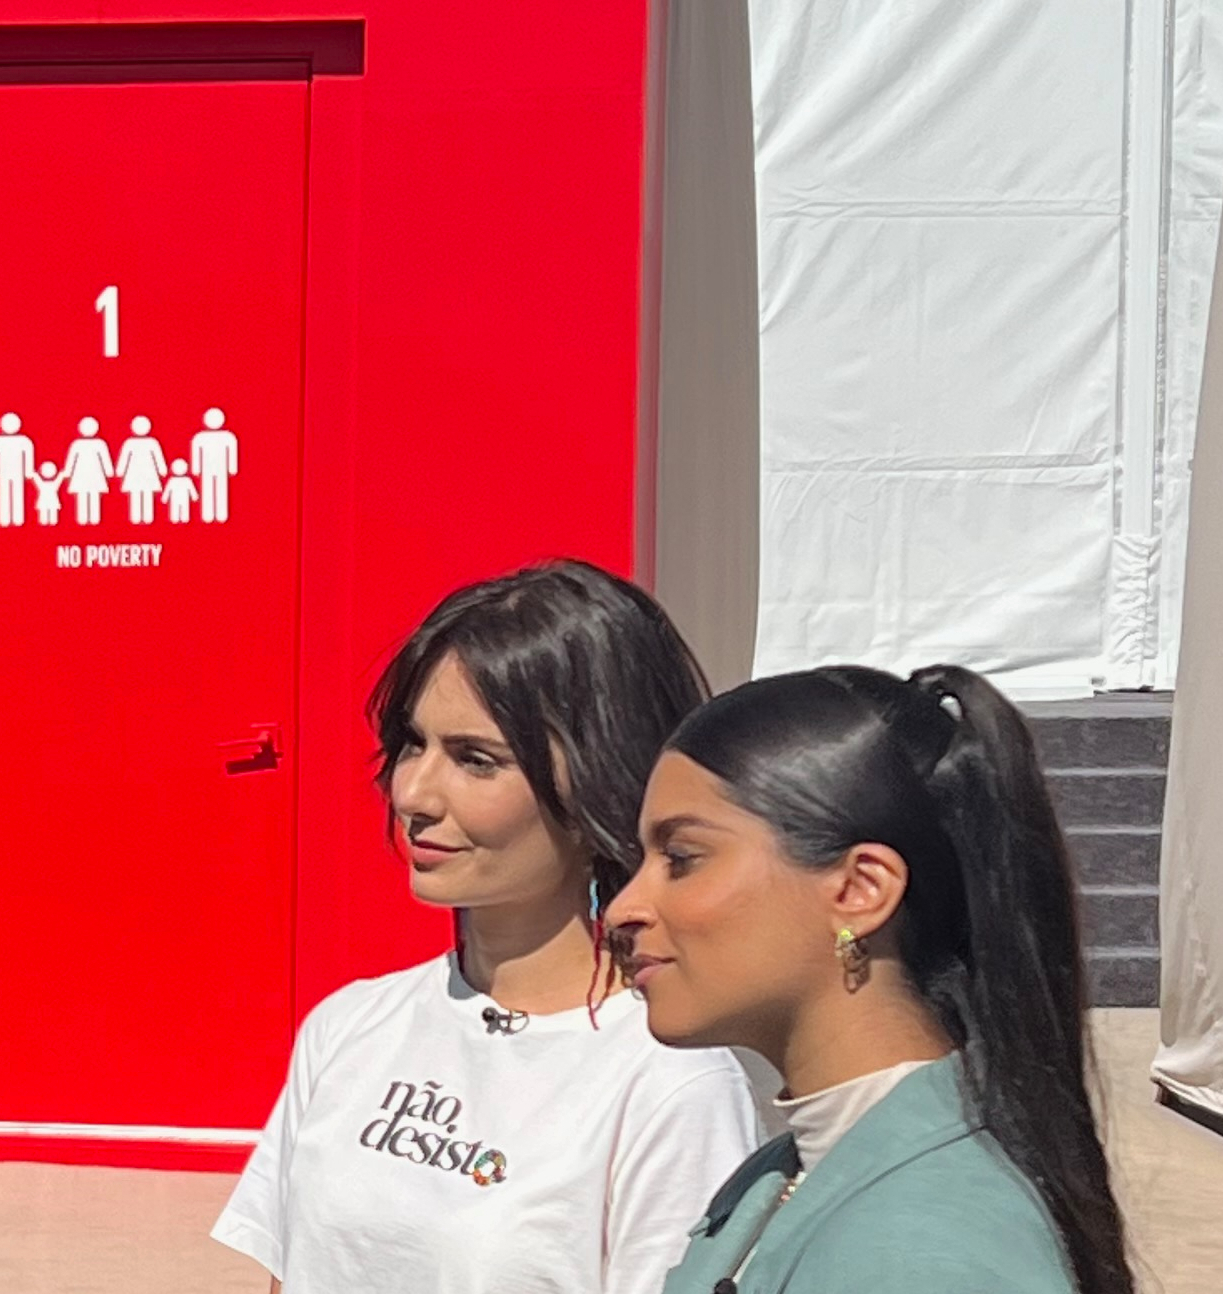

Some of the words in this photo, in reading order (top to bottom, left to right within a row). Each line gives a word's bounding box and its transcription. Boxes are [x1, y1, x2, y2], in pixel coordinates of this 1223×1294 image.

[94, 285, 119, 358] 1
[57, 545, 81, 568] NO
[86, 543, 162, 567] POVERTY
